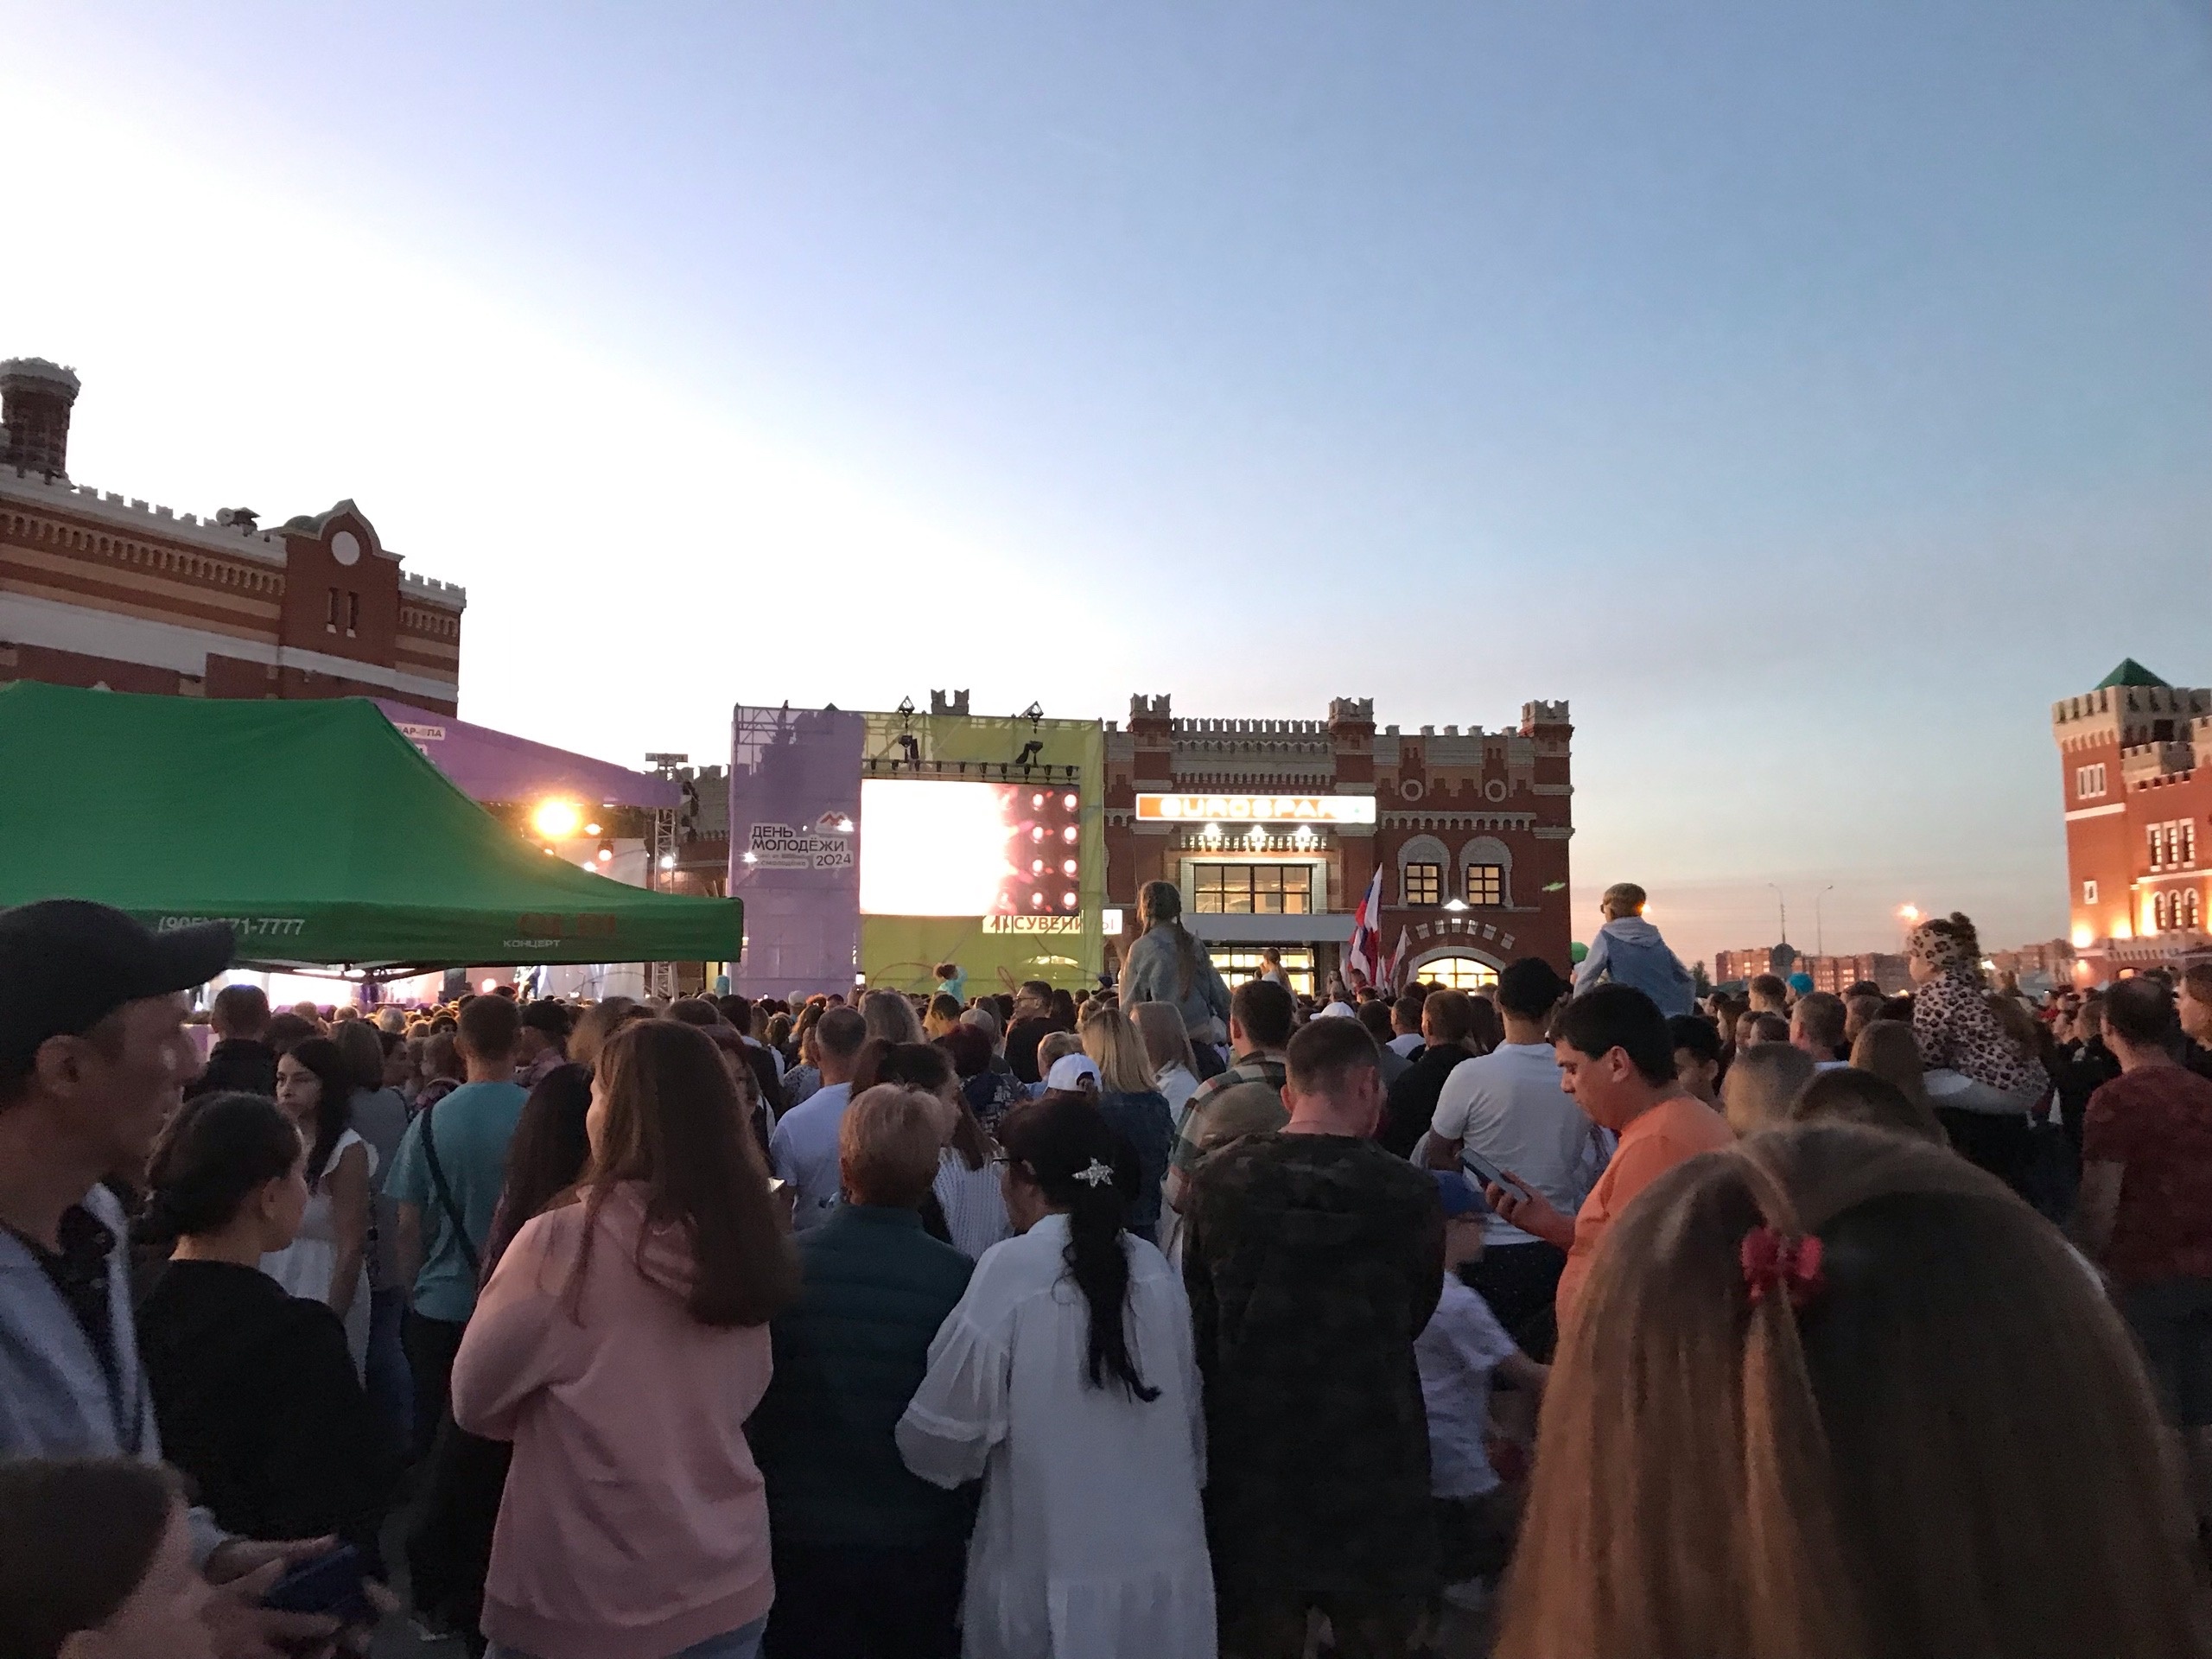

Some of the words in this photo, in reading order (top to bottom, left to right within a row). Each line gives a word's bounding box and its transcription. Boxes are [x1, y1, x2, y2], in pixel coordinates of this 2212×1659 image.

[752, 826, 793, 839] ДЕНЬ
[752, 837, 844, 853] МОЛОДЁЖИ
[816, 854, 851, 867] 2024
[212, 918, 305, 936] 71-7777
[503, 939, 561, 949] КОНЦЕРТ
